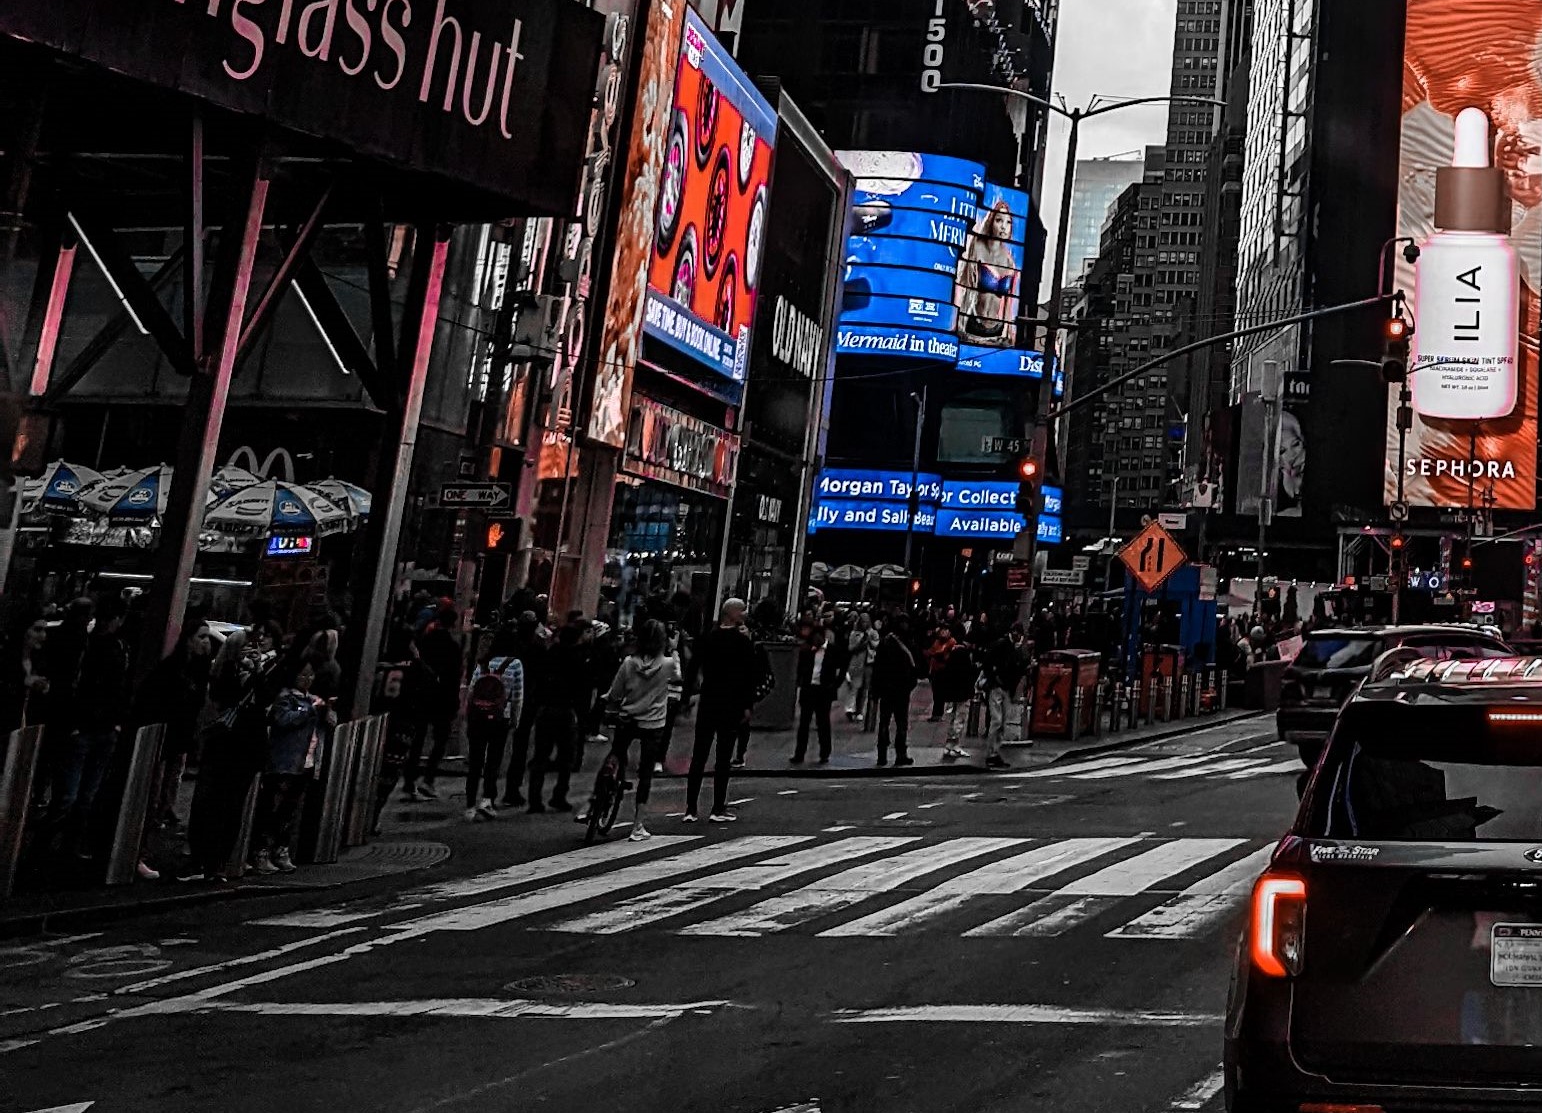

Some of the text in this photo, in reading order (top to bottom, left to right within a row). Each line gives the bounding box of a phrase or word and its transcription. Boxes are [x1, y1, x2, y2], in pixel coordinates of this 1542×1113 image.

[1453, 265, 1482, 341] ILIA
[772, 294, 824, 381] OLD NAVY
[837, 331, 909, 351] Mermaid
[909, 334, 925, 353] in
[1417, 354, 1435, 363] SUPER
[1007, 439, 1020, 453] 45
[1406, 458, 1516, 479] SEPHORA
[445, 489, 501, 501] ONE WAY
[889, 479, 931, 499] Tayor
[843, 507, 878, 524] and
[950, 517, 1022, 534] Available
[1352, 845, 1380, 856] STAR
